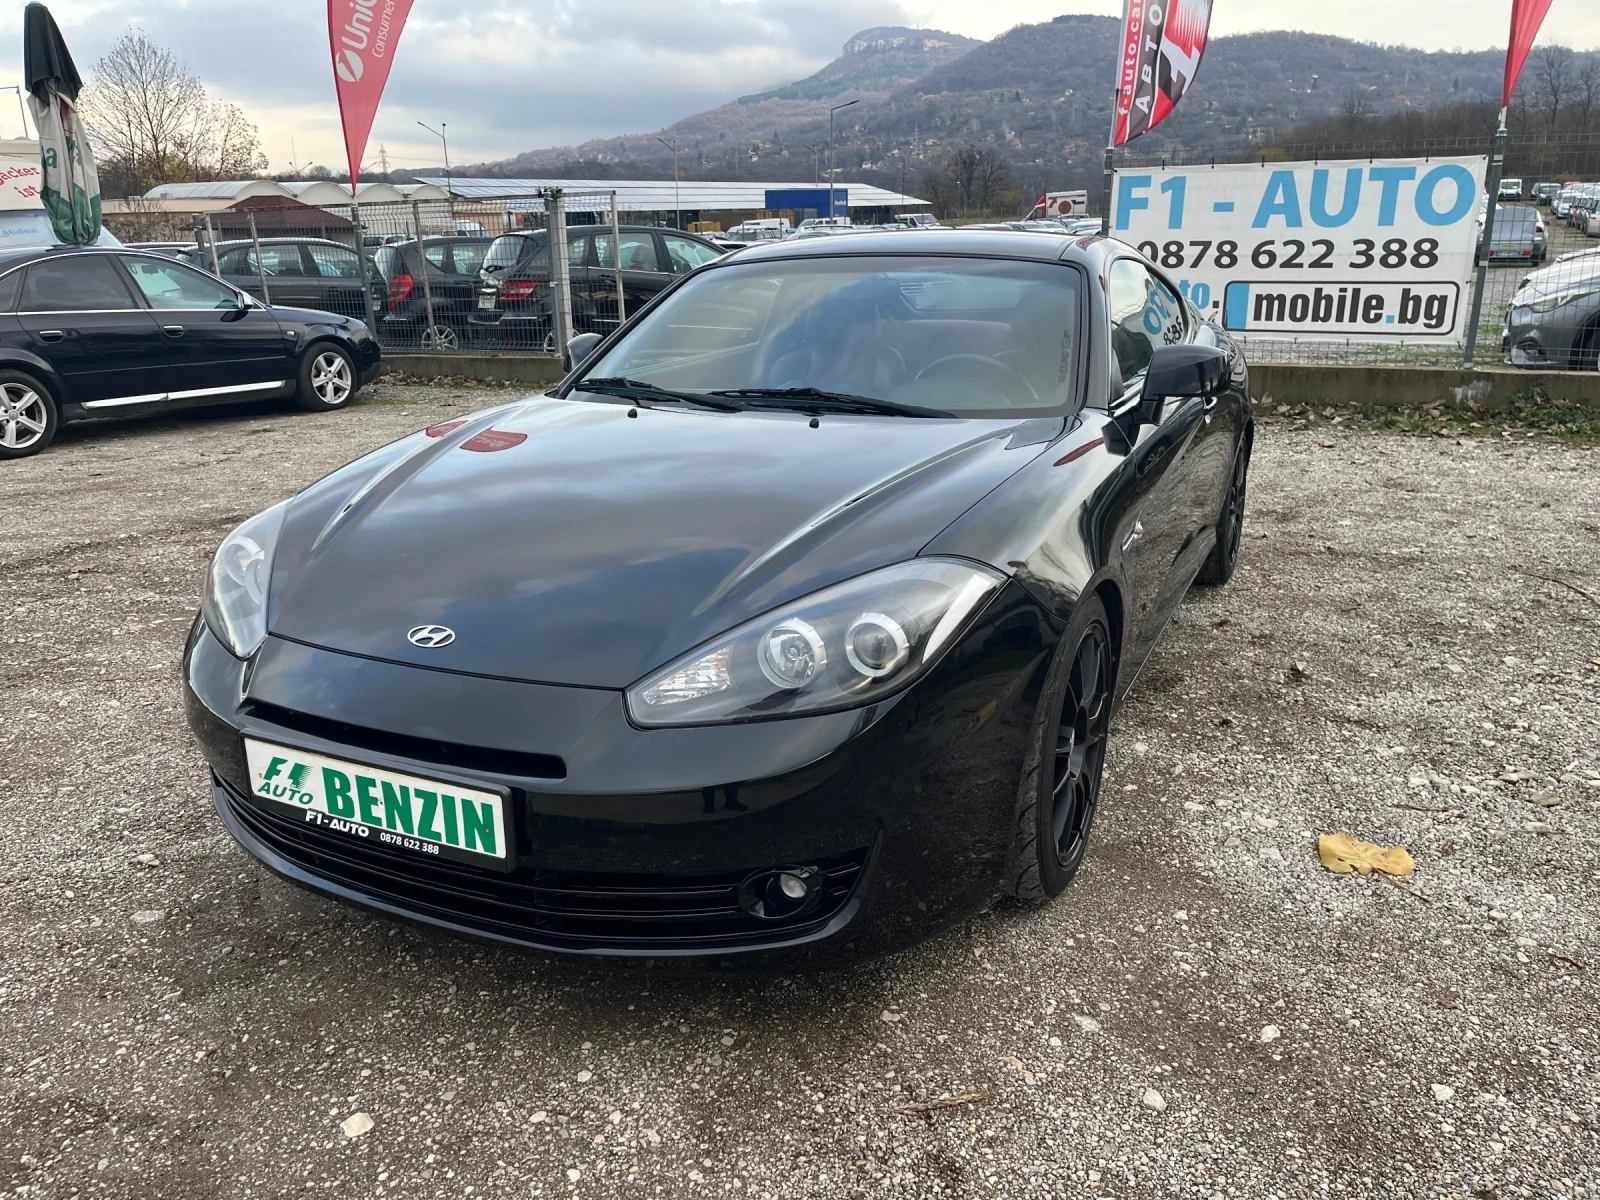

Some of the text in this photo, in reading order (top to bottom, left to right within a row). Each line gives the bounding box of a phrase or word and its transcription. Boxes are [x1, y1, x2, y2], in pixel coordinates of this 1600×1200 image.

[1115, 174, 1187, 231] F1
[1251, 164, 1476, 229] AUTO
[1137, 238, 1440, 269] 0878 622 388
[1253, 287, 1448, 329] mobile.bg
[257, 781, 314, 805] AUTO
[322, 766, 497, 855] BENZIN
[380, 832, 402, 846] 0878
[403, 838, 420, 850] 622
[421, 843, 440, 855] 388
